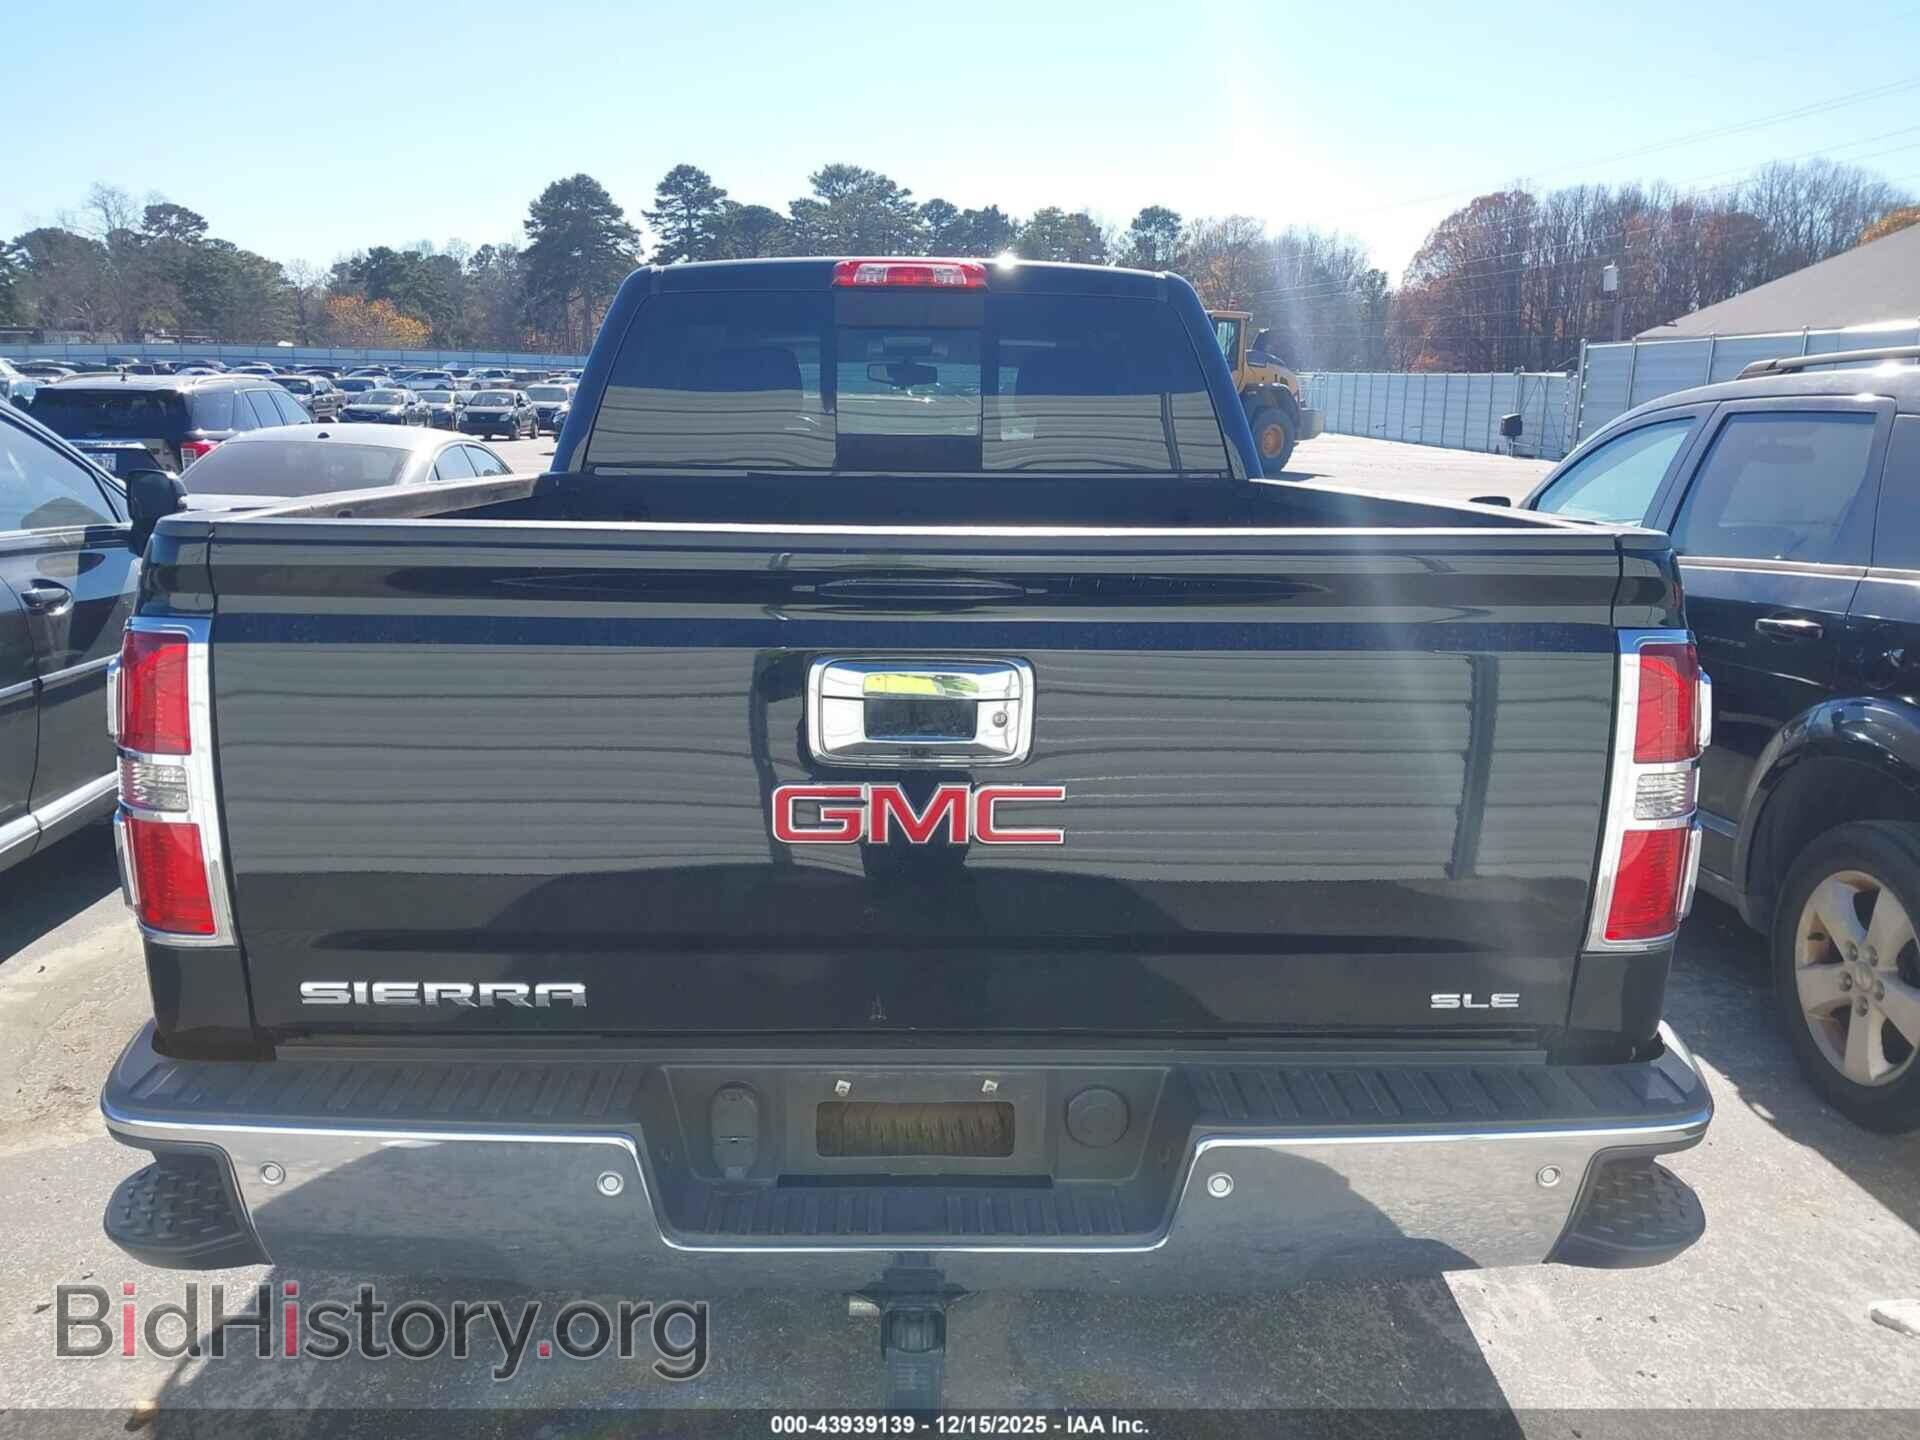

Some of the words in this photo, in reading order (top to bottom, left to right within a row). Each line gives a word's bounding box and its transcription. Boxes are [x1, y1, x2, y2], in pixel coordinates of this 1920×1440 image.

[772, 784, 1067, 844] GMC
[300, 981, 587, 1007] SIERRA
[1430, 993, 1519, 1008] SLE
